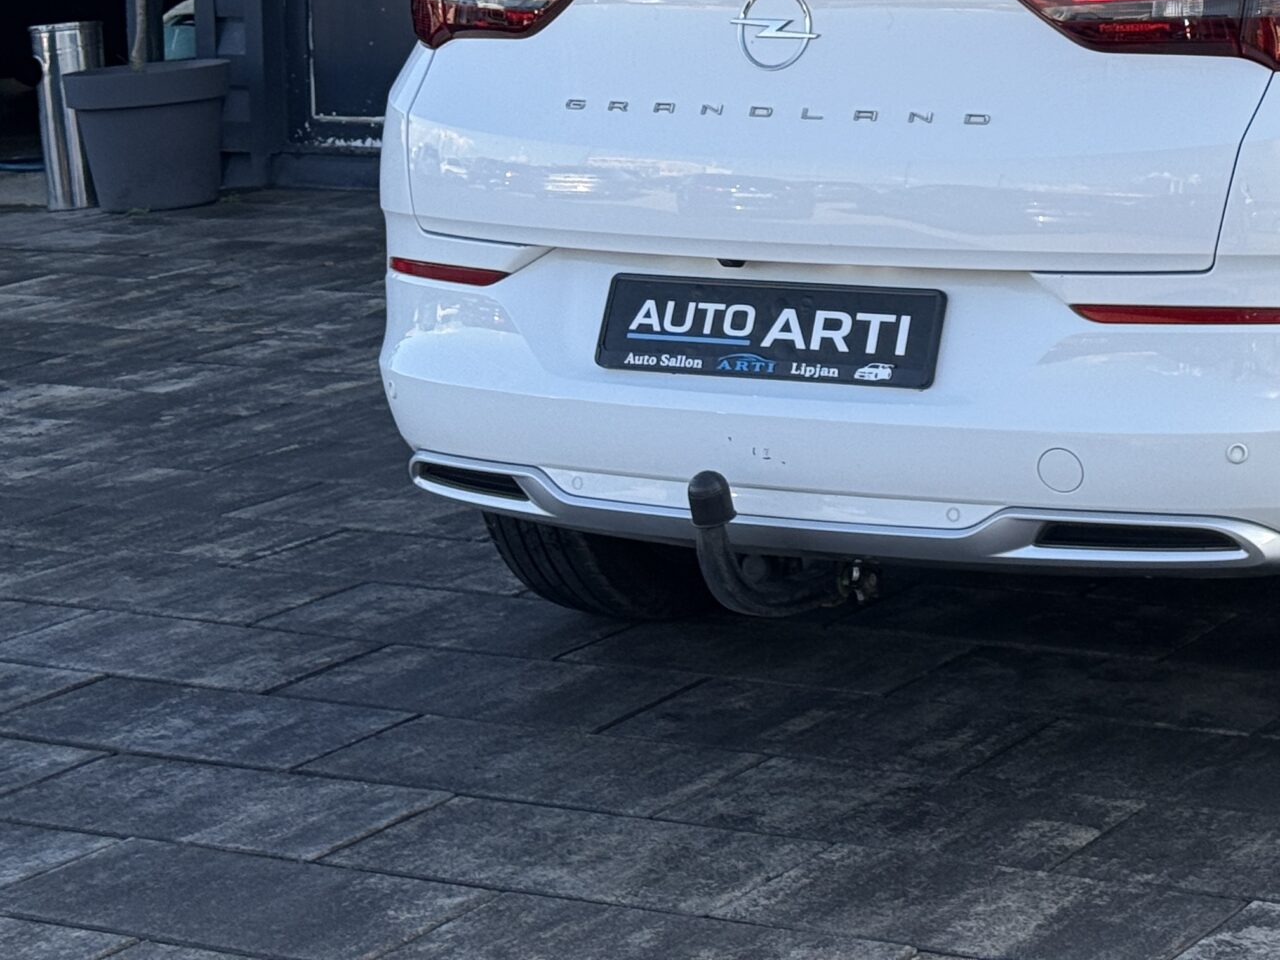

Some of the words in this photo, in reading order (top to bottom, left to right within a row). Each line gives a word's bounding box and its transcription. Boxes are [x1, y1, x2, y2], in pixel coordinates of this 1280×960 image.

[565, 98, 991, 126] GRANDLAND
[628, 299, 756, 338] AUTO
[759, 307, 912, 357] ARTI
[624, 352, 657, 366] Auto
[659, 353, 703, 369] Sallon
[716, 359, 776, 373] ARTI
[790, 362, 839, 378] Lipjan
